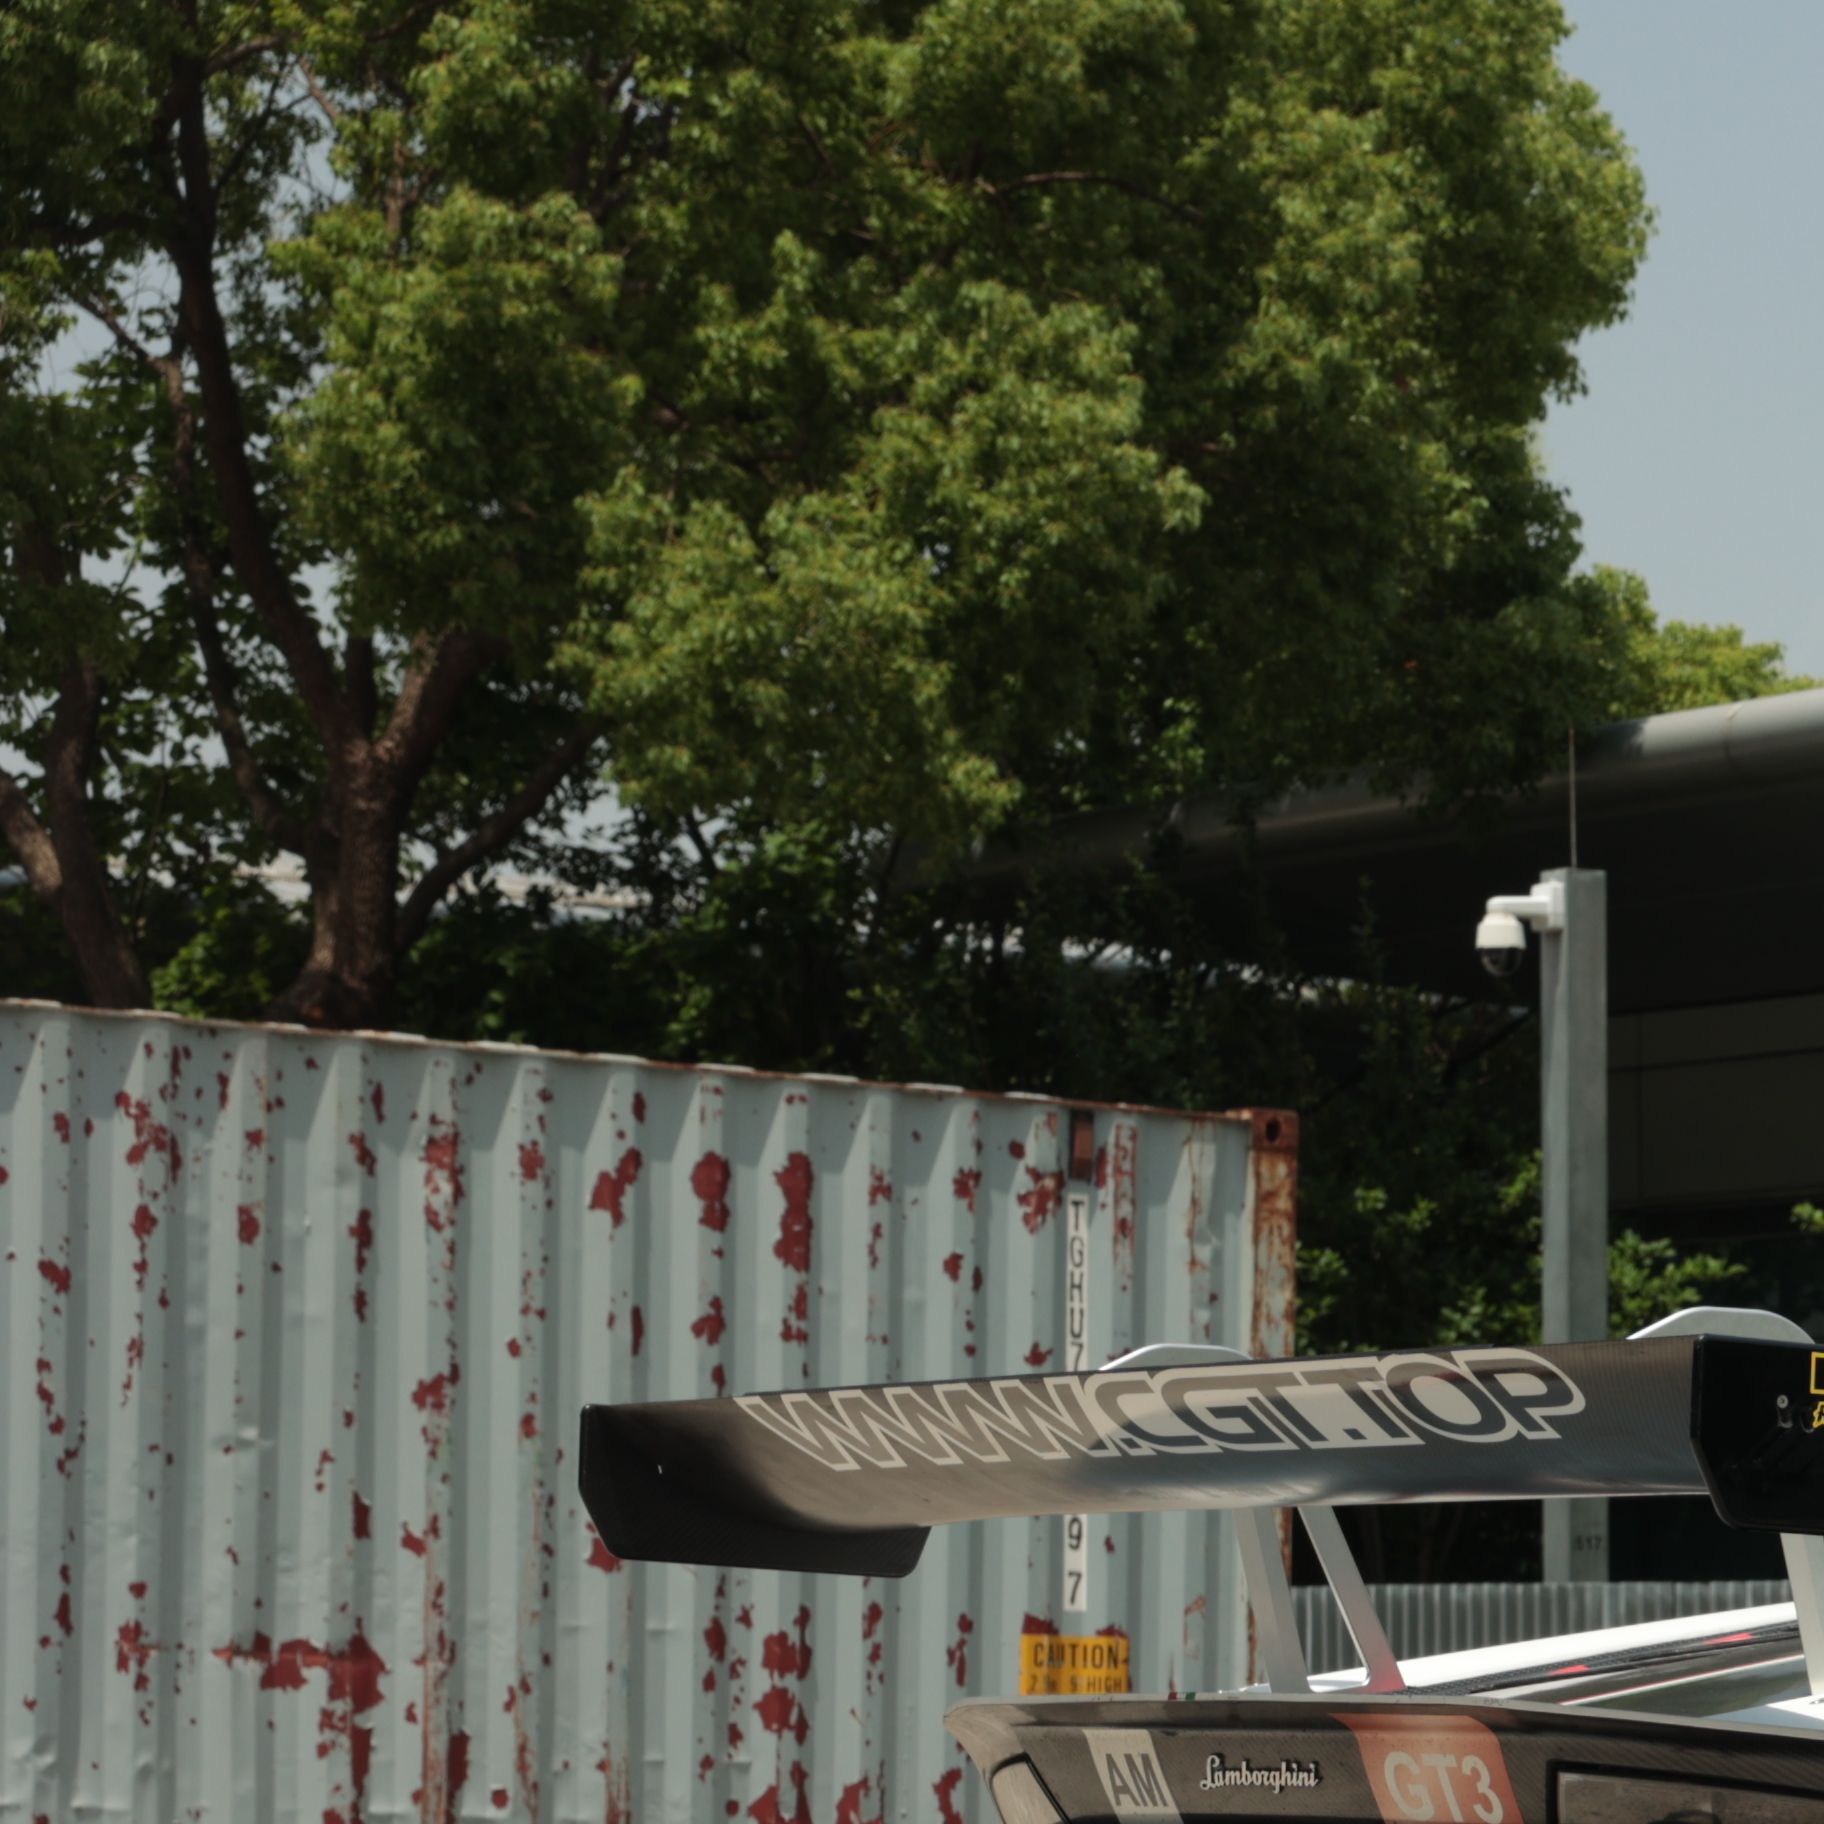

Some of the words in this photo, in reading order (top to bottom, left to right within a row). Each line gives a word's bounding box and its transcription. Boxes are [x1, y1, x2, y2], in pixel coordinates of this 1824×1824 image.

[733, 1347, 1586, 1471] WWW.CGT.TOP
[1032, 1642, 1120, 1671] CAUTION
[1104, 1752, 1170, 1808] AM
[1199, 1752, 1323, 1794] Lamborghini
